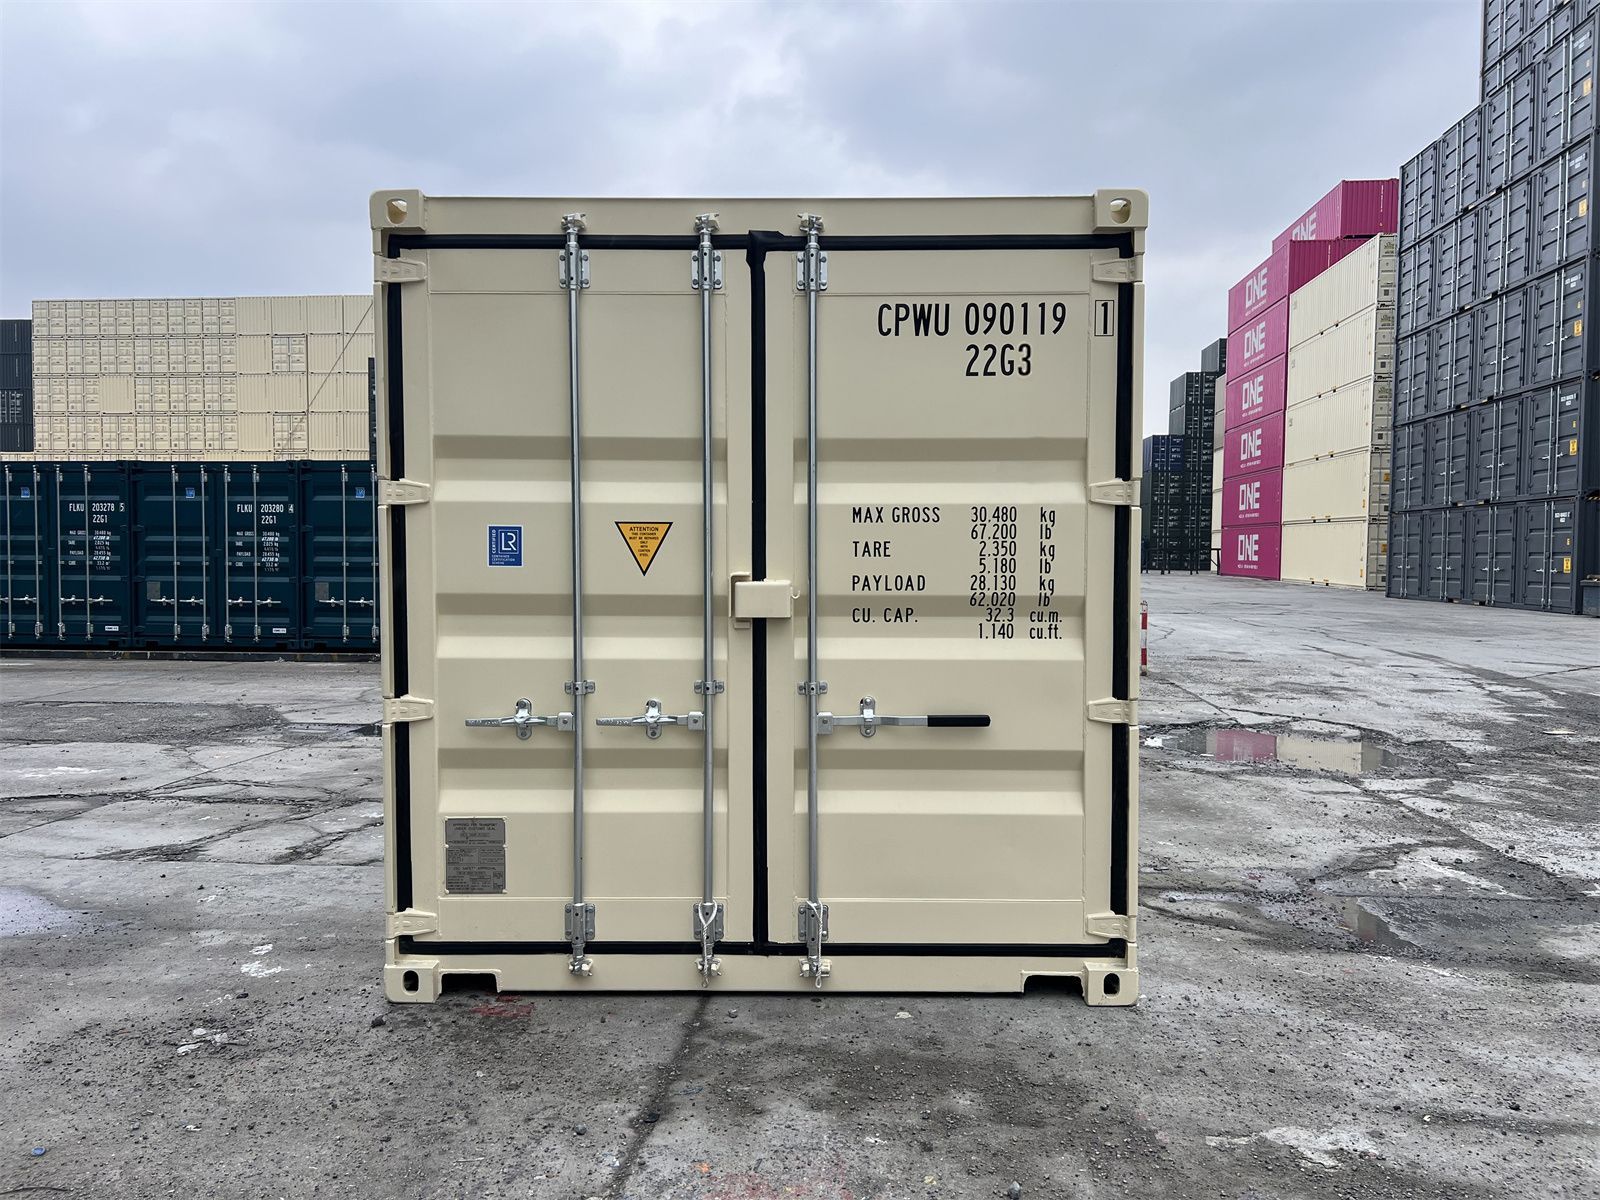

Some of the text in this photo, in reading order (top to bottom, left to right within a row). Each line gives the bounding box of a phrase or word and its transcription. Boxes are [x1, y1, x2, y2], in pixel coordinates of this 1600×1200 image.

[1246, 267, 1268, 308] ONE
[878, 303, 950, 337] CPWU
[964, 302, 1066, 336] 090119
[1244, 321, 1266, 360] ONE
[965, 343, 1032, 377] 22G3
[1242, 375, 1264, 410] ONE
[1240, 428, 1262, 460] ONE
[1239, 482, 1260, 510] ONE
[69, 503, 84, 512] FLKU
[92, 503, 114, 512] 203278
[237, 504, 252, 512] FLKU
[260, 504, 284, 512] 203280
[852, 507, 884, 523] MAX
[892, 507, 940, 523] GROSS
[1040, 507, 1056, 527] kg
[92, 514, 108, 523] 22G1
[261, 516, 276, 524] 22G1
[502, 532, 516, 550] LR
[1040, 524, 1052, 539] lb
[852, 541, 891, 557] TARE
[1040, 541, 1056, 561] kg
[1238, 534, 1259, 561] ONE
[1040, 558, 1051, 574] lb
[852, 575, 926, 591] PAYLOAD
[1040, 575, 1055, 595] kg
[1038, 593, 1050, 606] lb
[852, 608, 1062, 622] CU. CAP. 32.3 cu.m.
[1030, 624, 1062, 639] cu.ft.
